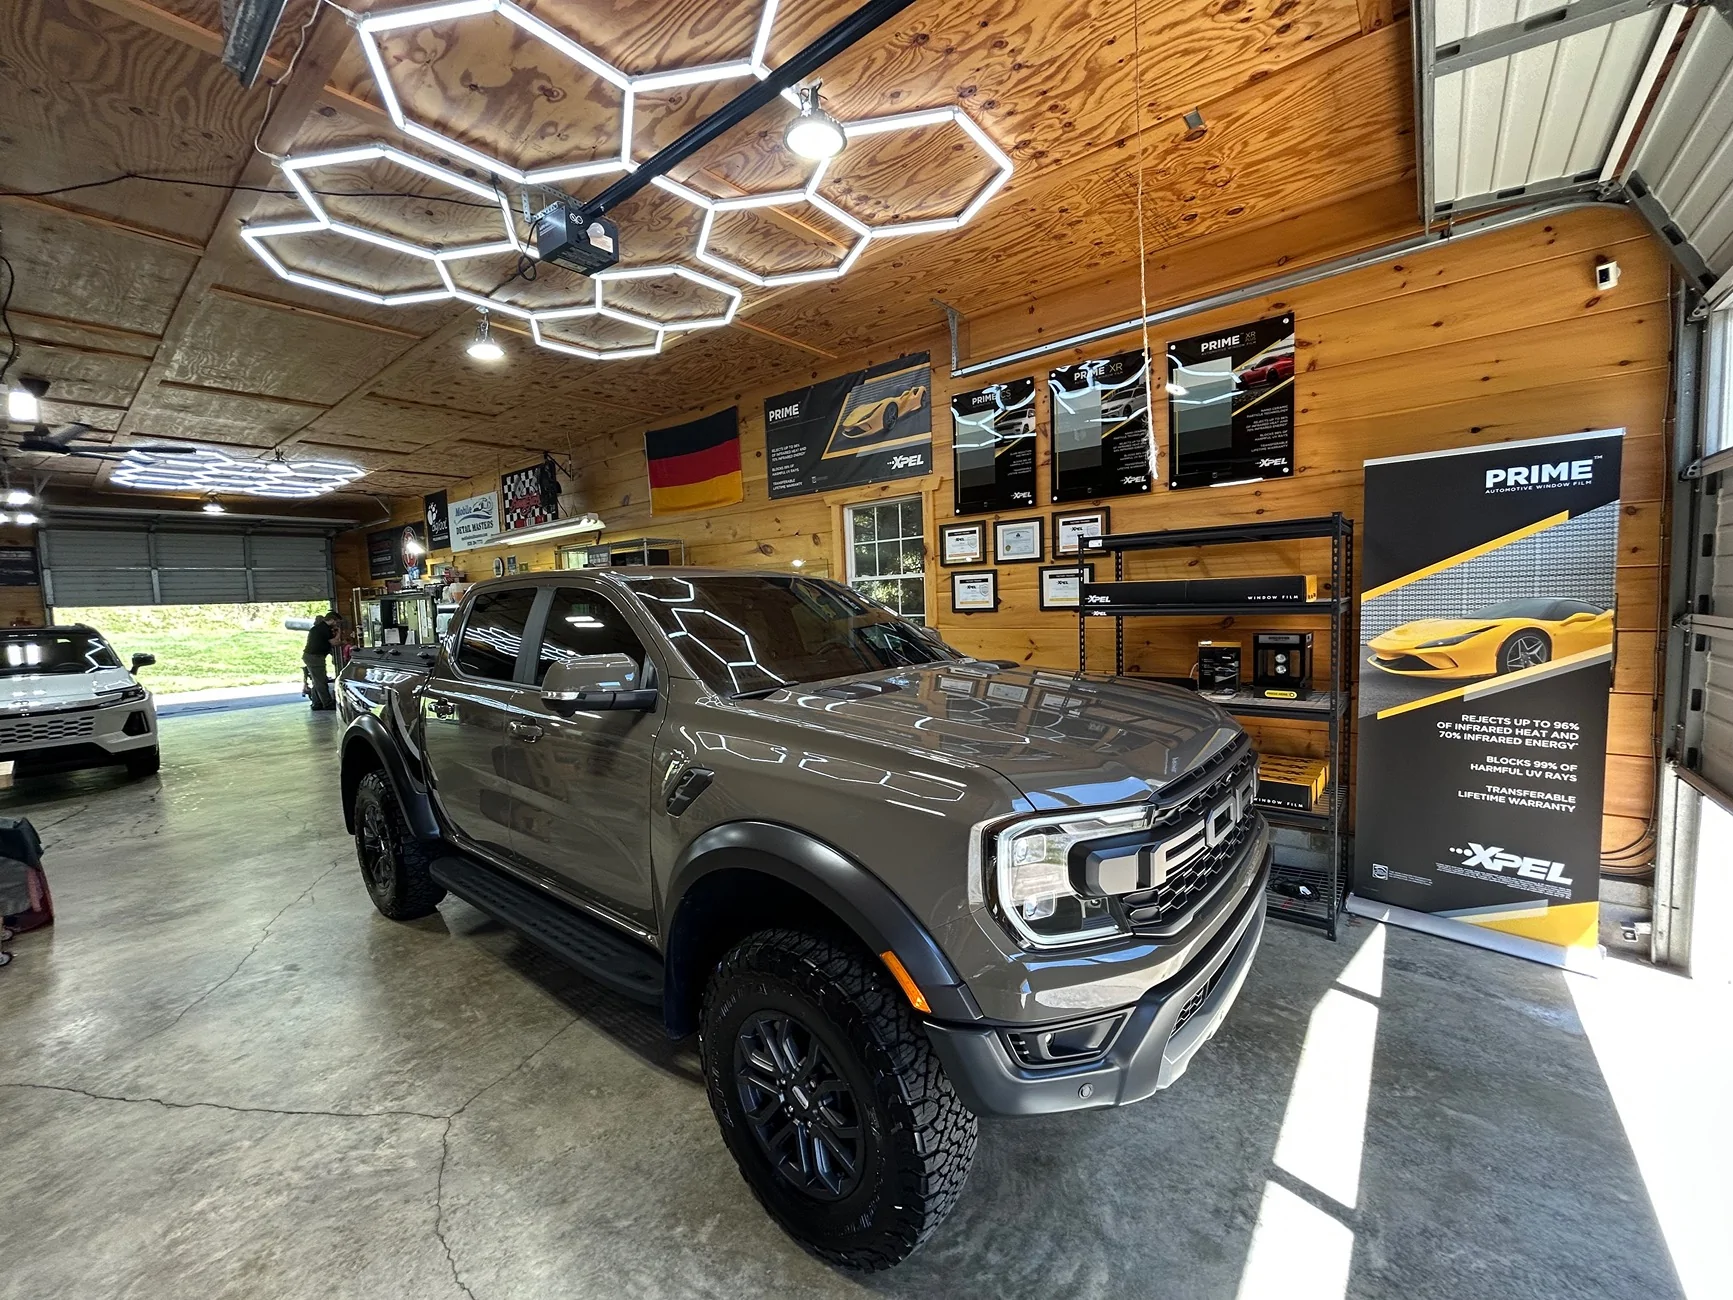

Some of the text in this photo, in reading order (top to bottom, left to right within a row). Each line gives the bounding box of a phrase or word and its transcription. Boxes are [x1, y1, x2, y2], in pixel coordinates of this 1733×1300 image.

[1201, 335, 1240, 352] PRIME
[1074, 367, 1105, 380] PRME
[1110, 363, 1122, 373] XR
[769, 404, 799, 421] PRIME
[891, 454, 924, 470] XPEL
[1259, 458, 1287, 467] XPEL
[1123, 476, 1146, 484] XPEL
[1485, 459, 1593, 488] PRIME
[1485, 485, 1533, 494] AUTOMOTIVE
[1536, 482, 1570, 490] WINDOW
[455, 505, 472, 517] Mobile
[456, 520, 493, 535] DETAIL MASTERS
[1088, 595, 1110, 603] XPEL
[1462, 714, 1580, 730] REJECTS UP TO 96%
[1439, 731, 1461, 739] 70%
[1464, 733, 1522, 745] INFRARED
[1455, 723, 1512, 735] INFRARED
[1515, 729, 1548, 738] HEAT
[1550, 731, 1579, 740] AND
[1486, 756, 1531, 766] BLOCKS
[1534, 761, 1557, 770] 99%
[1470, 764, 1577, 782] HARMFUL UV RAYS
[1458, 791, 1576, 813] LIFETIME WARRANTY
[1486, 785, 1576, 803] TRANSFERABLE
[1461, 842, 1573, 885] XPEL
